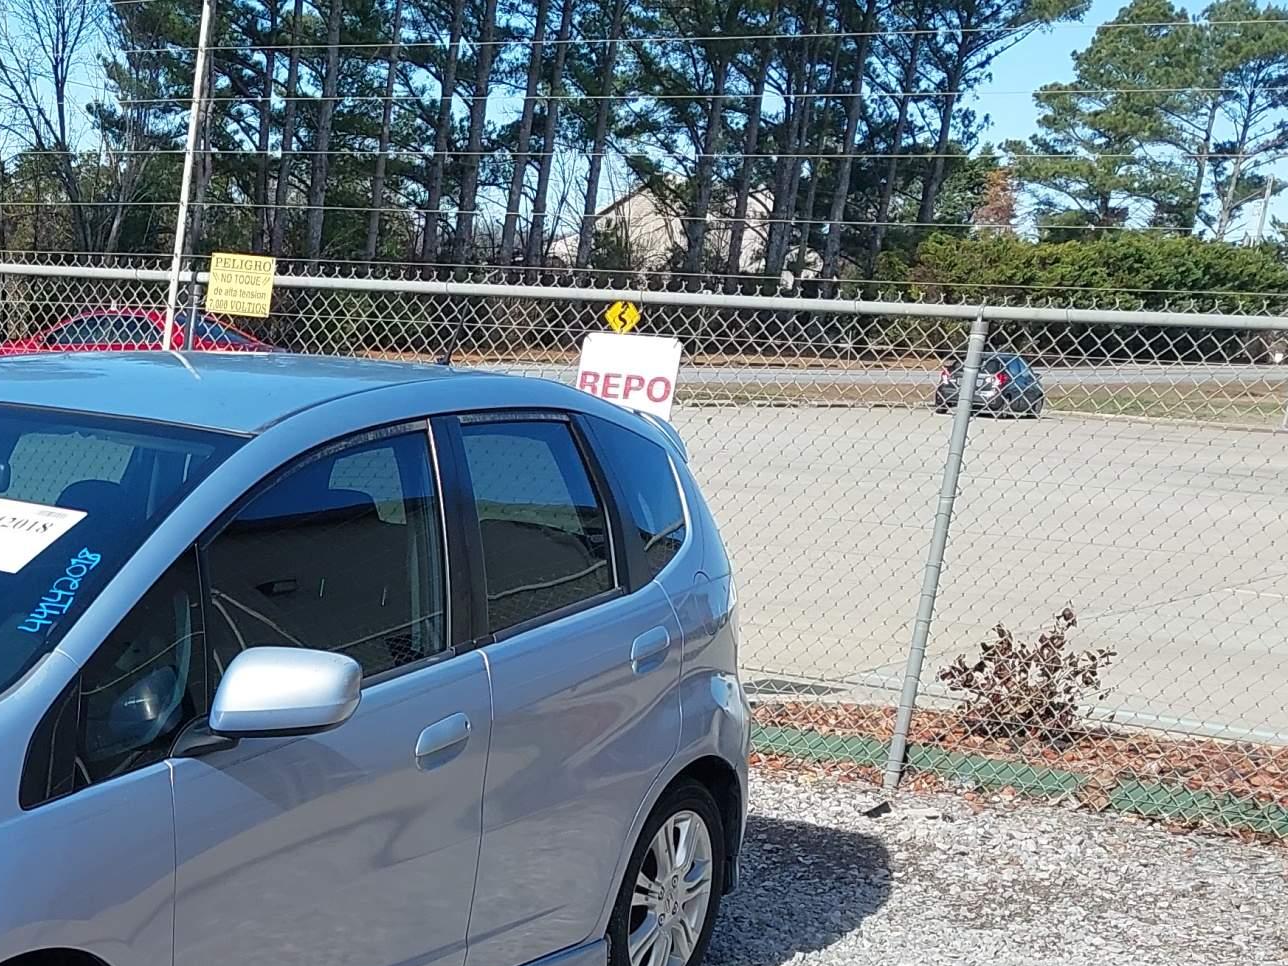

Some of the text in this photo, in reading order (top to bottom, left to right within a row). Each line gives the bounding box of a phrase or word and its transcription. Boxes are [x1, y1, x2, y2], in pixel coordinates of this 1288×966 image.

[215, 257, 272, 273] PELIGRO
[220, 273, 233, 283] NO
[213, 287, 223, 296] de
[230, 300, 267, 314] VOLTIOS
[579, 370, 672, 403] REPO
[17, 546, 102, 633] 44142018
